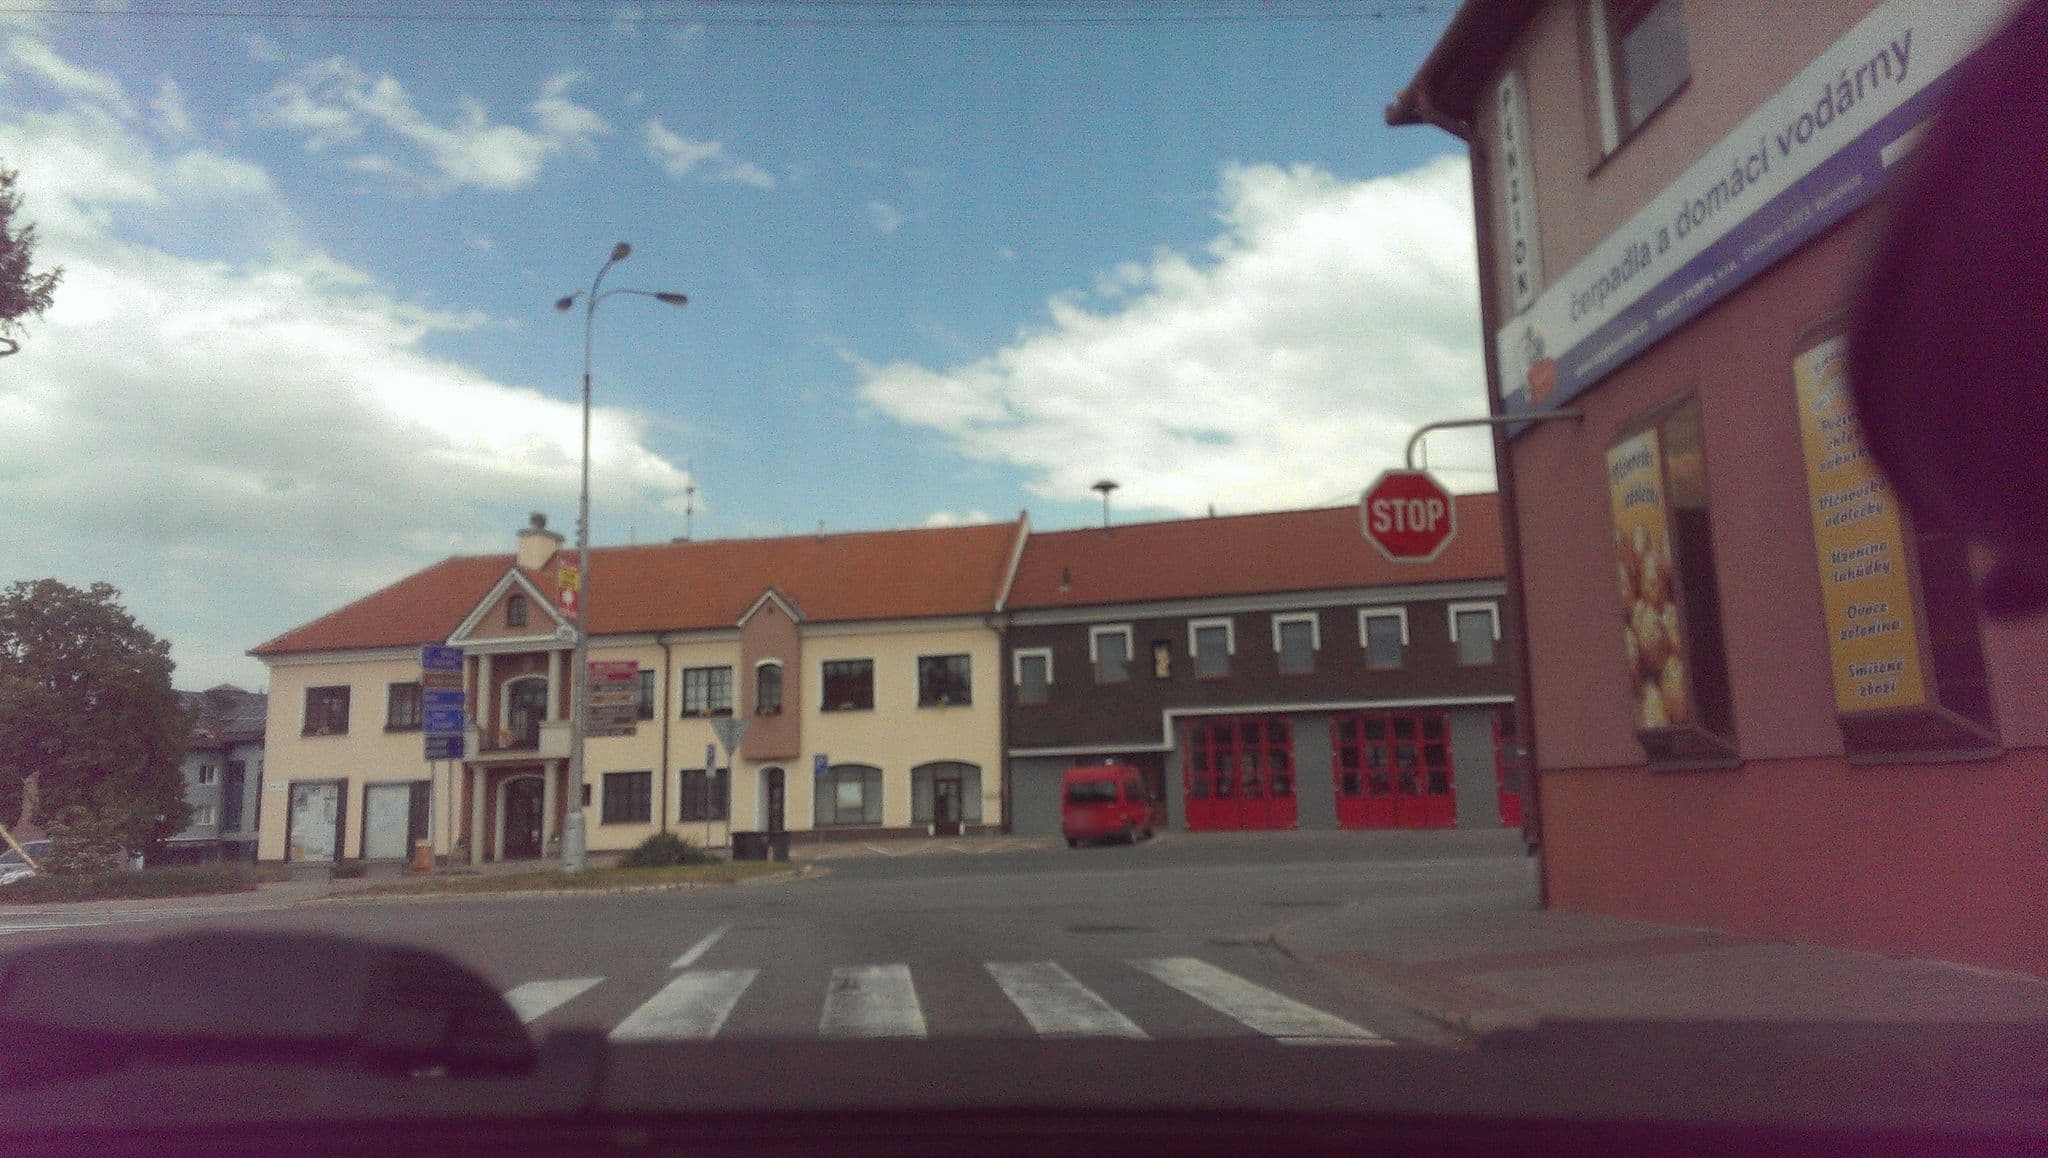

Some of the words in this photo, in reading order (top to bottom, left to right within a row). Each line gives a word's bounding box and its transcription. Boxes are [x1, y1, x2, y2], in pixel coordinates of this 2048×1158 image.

[1569, 240, 1651, 322] čerpadla
[1657, 228, 1671, 256] a
[1676, 131, 1771, 239] domácí
[1777, 29, 1914, 157] vodárny
[1373, 499, 1444, 533] STOP
[1847, 604, 1888, 619] Ovoce
[1840, 621, 1899, 641] zelenina
